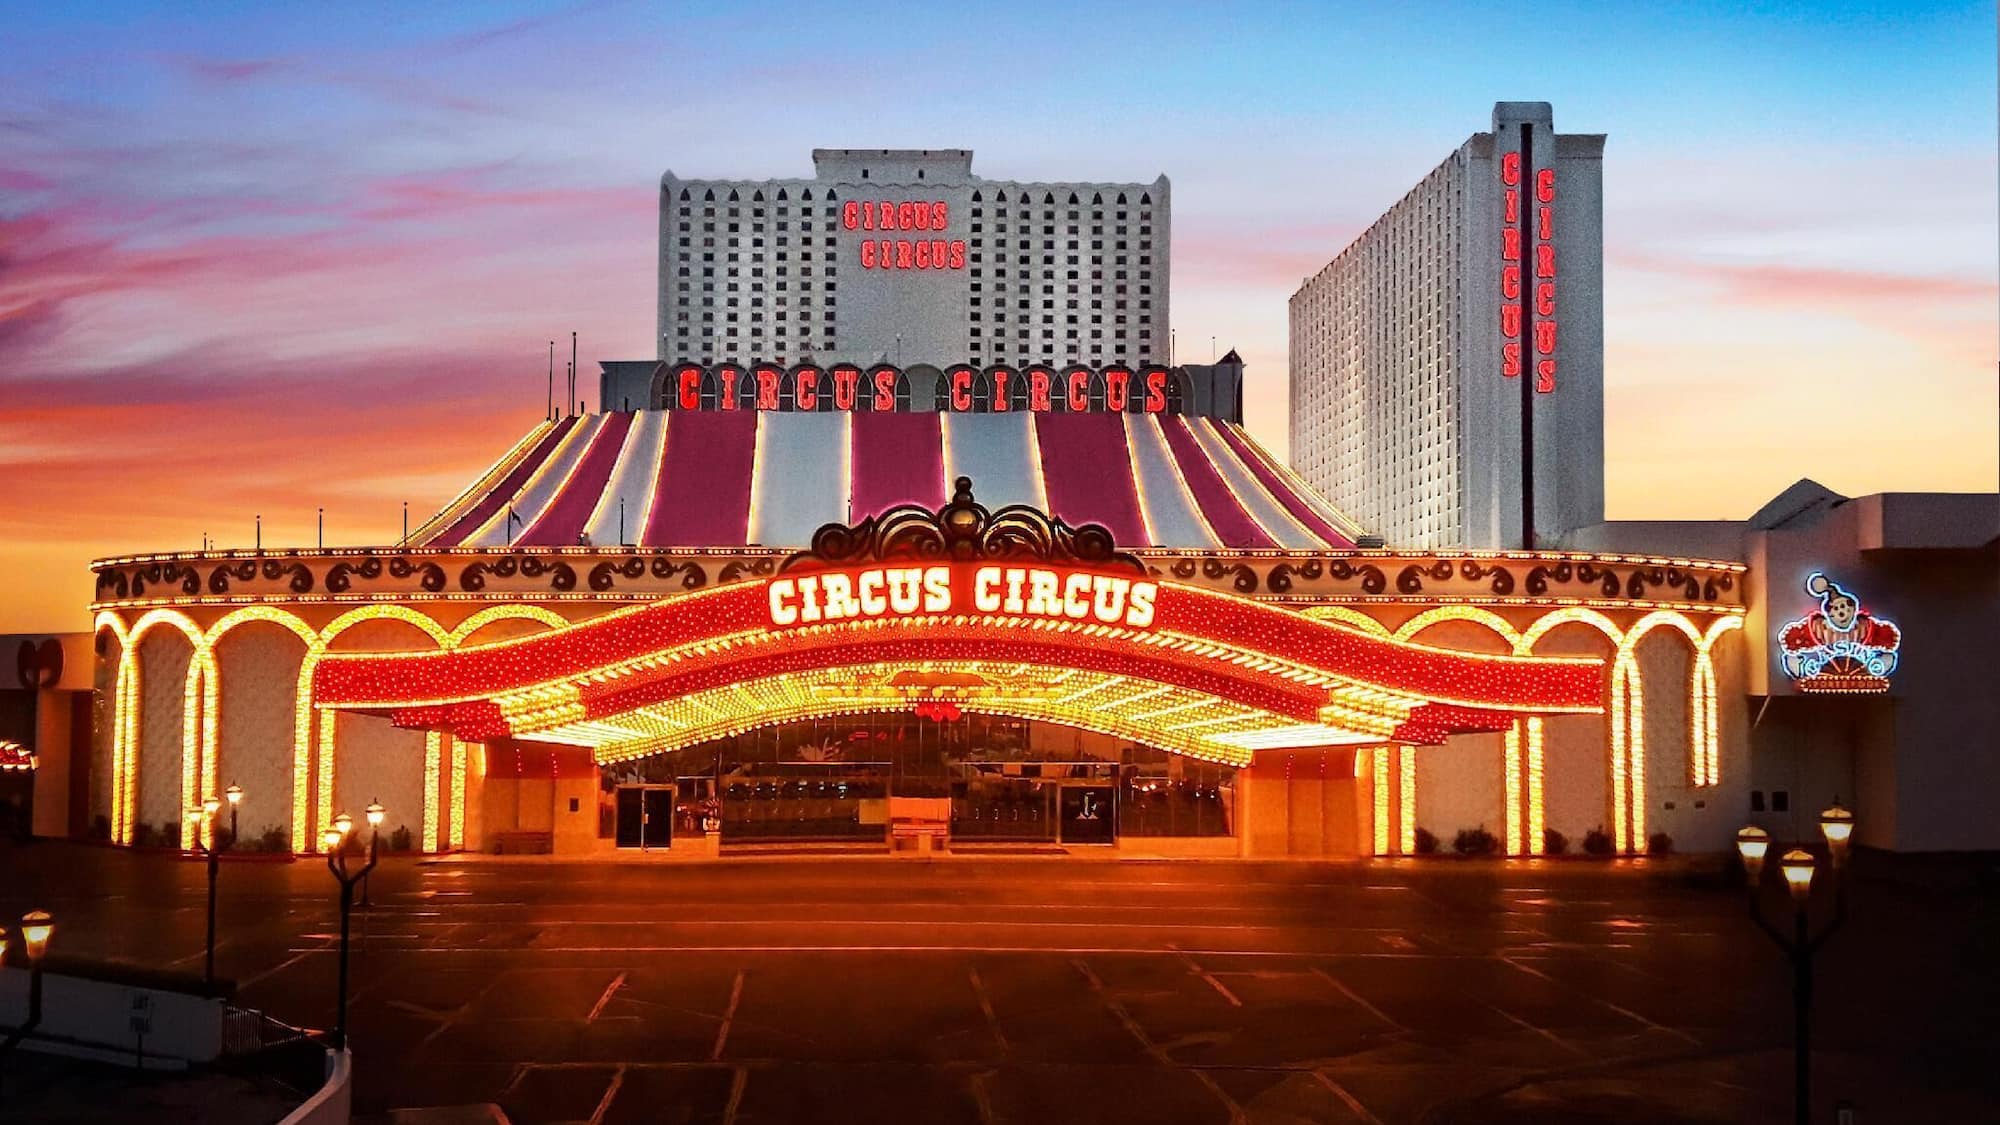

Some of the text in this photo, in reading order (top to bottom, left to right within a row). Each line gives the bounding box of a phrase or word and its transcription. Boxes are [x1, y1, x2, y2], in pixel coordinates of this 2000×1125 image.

[843, 200, 949, 232] CIRCUS
[861, 239, 966, 270] CIRCUS
[1502, 152, 1521, 377] CIRCUS
[1536, 169, 1556, 393] CIRCUS
[678, 368, 1168, 413] CIRCUS CIRCUS
[768, 566, 1159, 628] CIRCUS CIRCUS
[1804, 640, 1886, 677] CASINO
